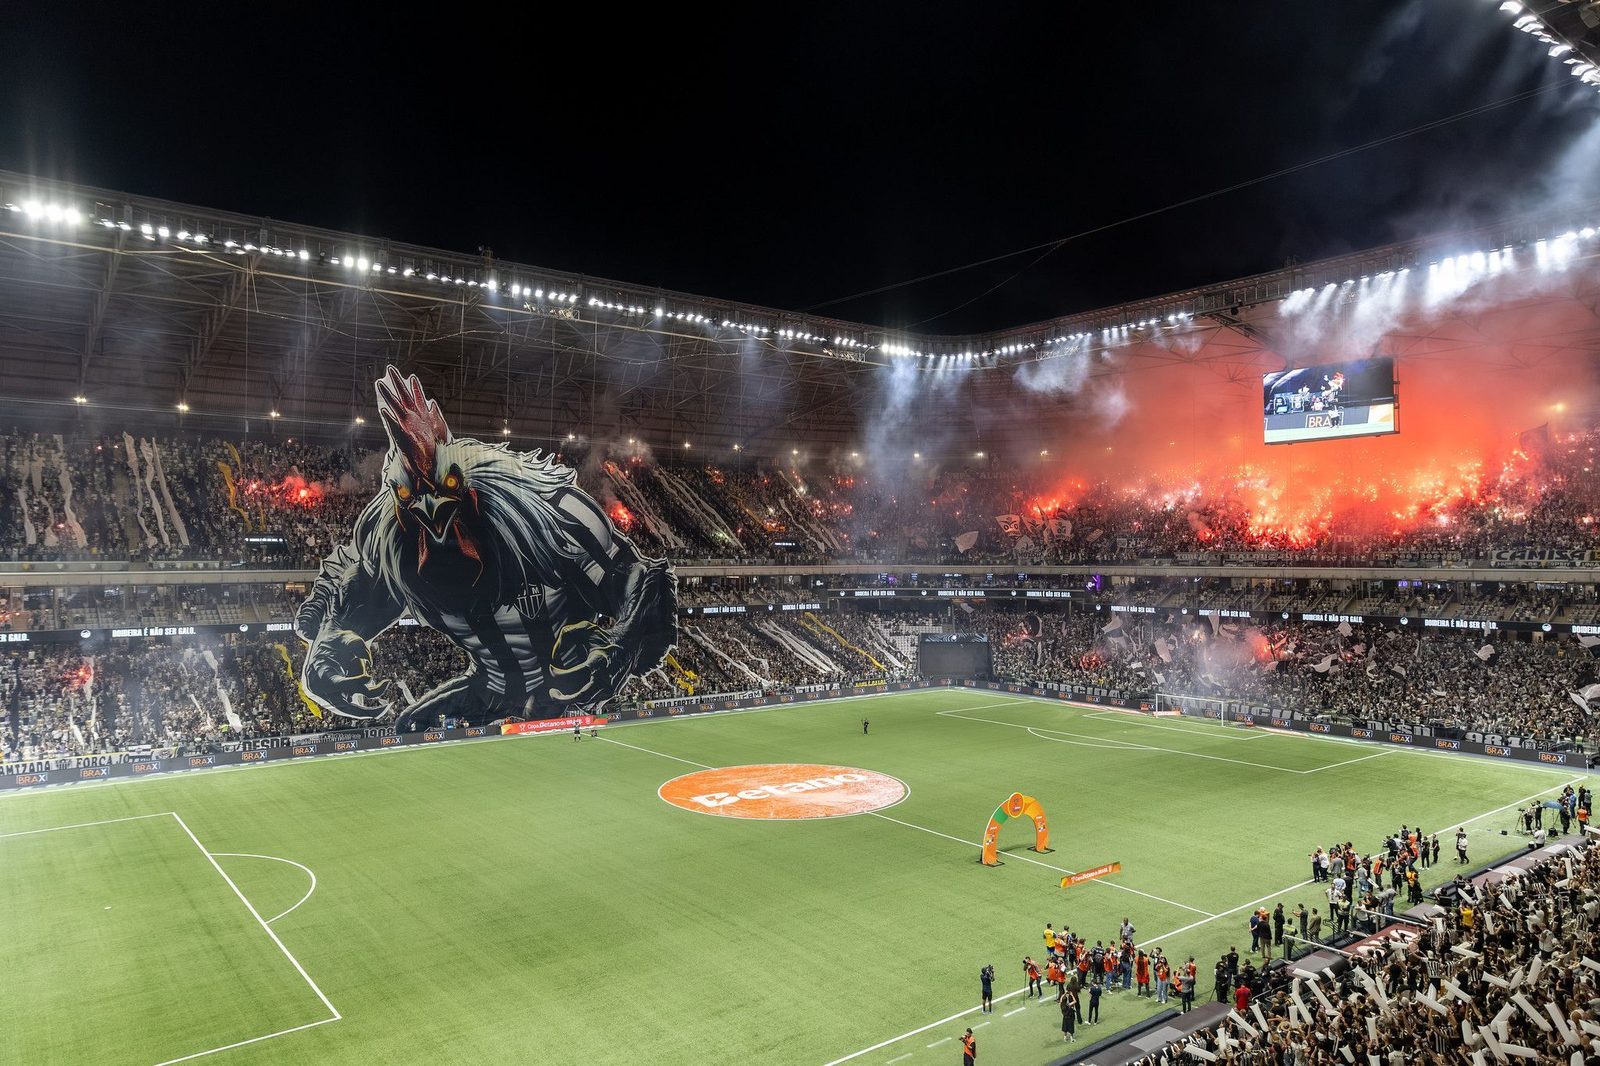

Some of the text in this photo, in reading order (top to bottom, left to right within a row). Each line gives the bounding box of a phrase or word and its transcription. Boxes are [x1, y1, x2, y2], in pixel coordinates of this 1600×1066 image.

[1309, 415, 1331, 428] BRA
[1496, 550, 1587, 561] CAMISA
[1328, 612, 1339, 622] NÃO
[1350, 615, 1364, 624] GALO.
[1450, 618, 1455, 628] É
[1456, 618, 1468, 628] NÃO
[1481, 621, 1498, 630] GLO.
[9, 632, 30, 642] GALO.
[112, 626, 196, 638] DOIDEIRA É NÃO SER GALO.
[1273, 719, 1290, 727] BRAX
[1311, 723, 1329, 733] BRAX
[425, 732, 444, 741] BRAX
[468, 727, 485, 737] BRAX
[1352, 728, 1371, 738] BRAX
[382, 736, 401, 745] BRAX
[1391, 734, 1410, 743] BRAX
[336, 740, 356, 750] BRAX
[1437, 740, 1458, 750] BRAX
[294, 746, 315, 755] BRAX
[1487, 746, 1509, 756] BRAX
[242, 751, 265, 761] BRAX
[1541, 753, 1564, 763] BRAX
[190, 757, 214, 767] BRAX
[134, 762, 158, 773] BRAX
[82, 768, 108, 778] BRAX
[18, 774, 46, 784] BRAX
[690, 773, 867, 808] Betano
